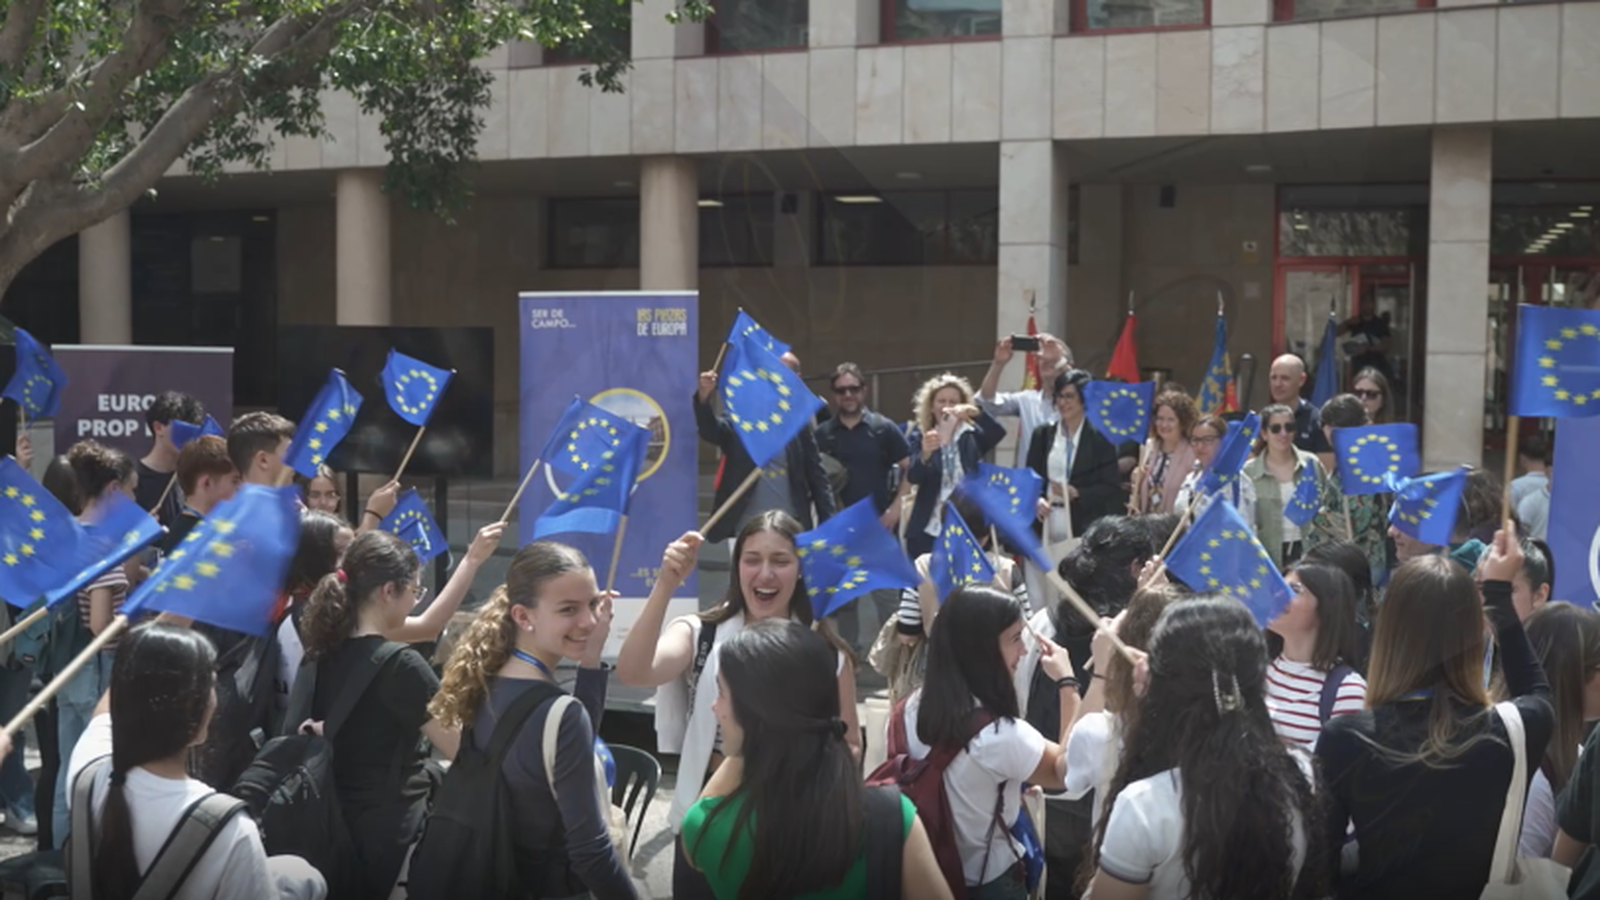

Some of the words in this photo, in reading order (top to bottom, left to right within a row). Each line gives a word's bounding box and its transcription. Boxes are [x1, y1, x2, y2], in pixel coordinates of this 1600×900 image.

[551, 309, 563, 318] DE
[637, 322, 648, 336] DE
[652, 322, 687, 336] EUROPA
[78, 419, 139, 437] PROP
